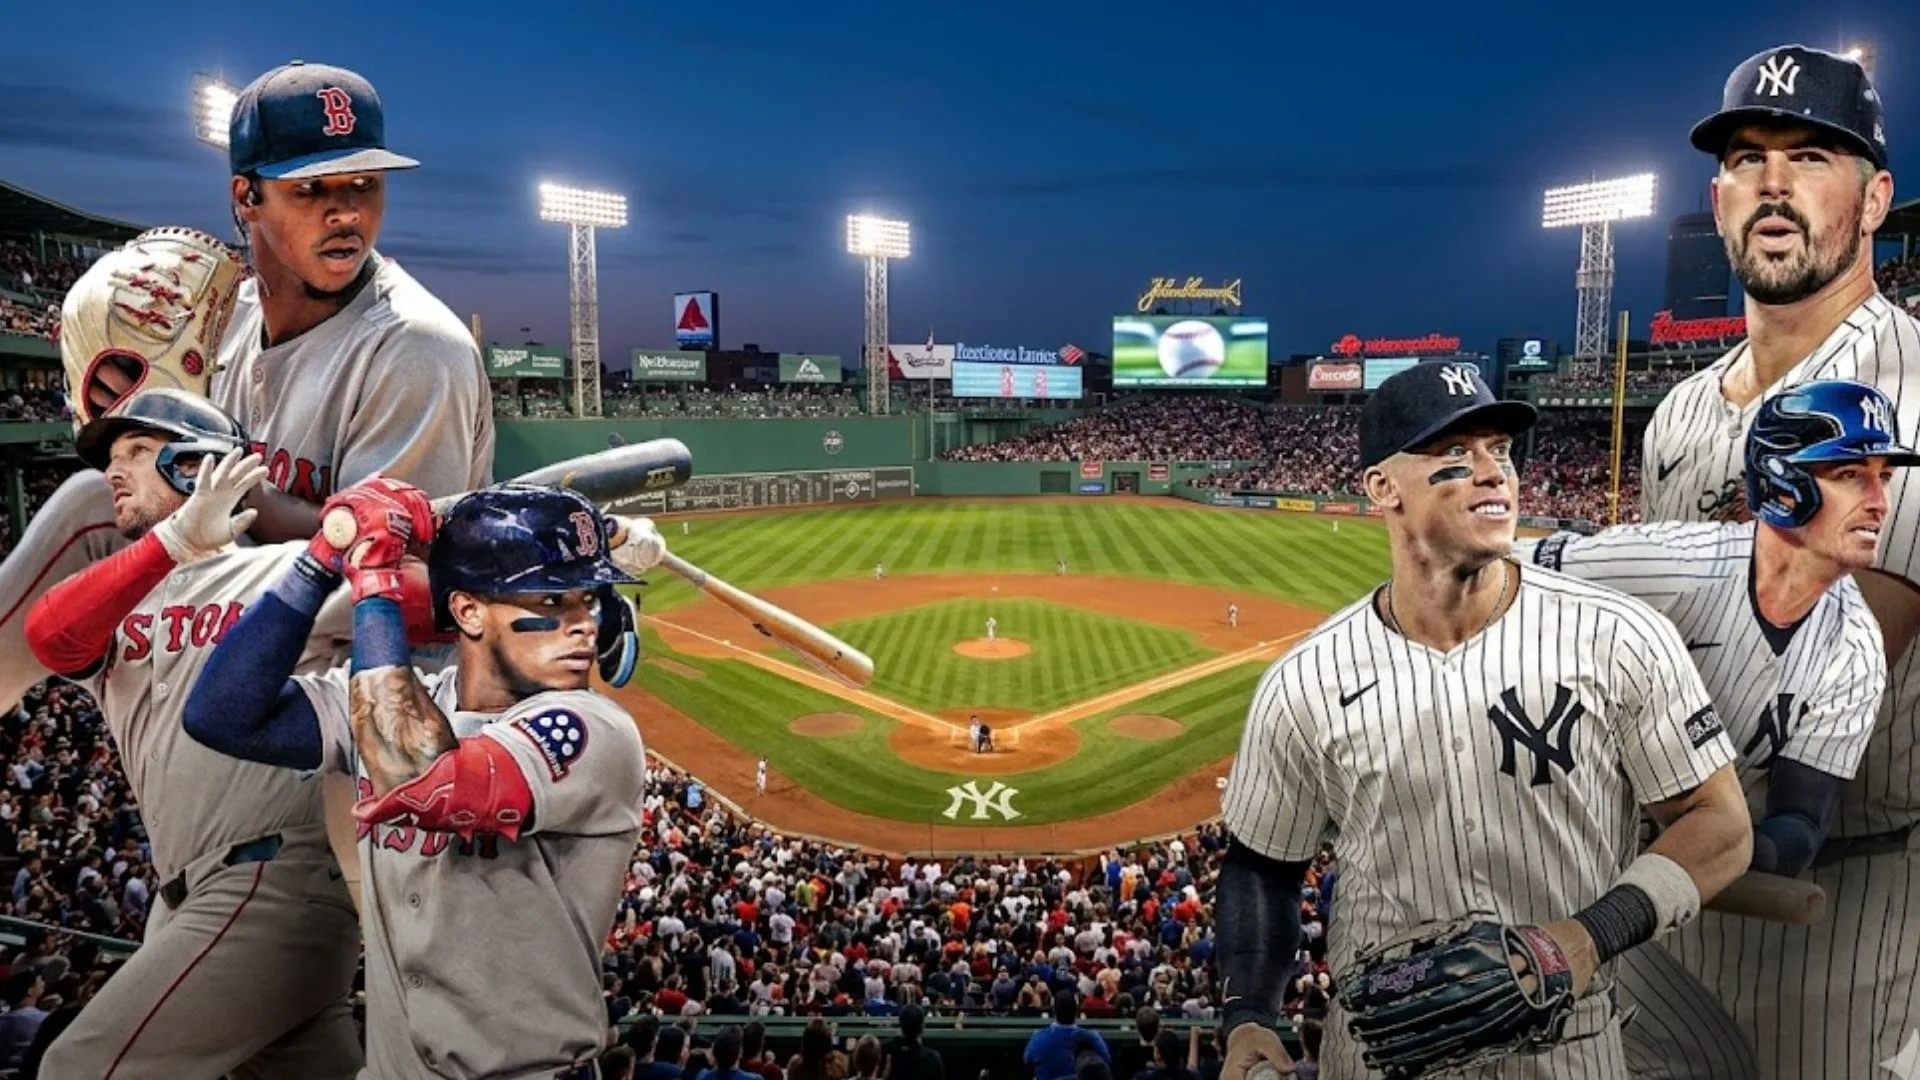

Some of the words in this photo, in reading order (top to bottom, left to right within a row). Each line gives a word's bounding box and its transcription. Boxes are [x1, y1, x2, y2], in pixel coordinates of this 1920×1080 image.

[1755, 55, 1800, 96] NY
[316, 87, 357, 136] B
[1440, 365, 1478, 396] NY
[1859, 396, 1893, 437] NY
[568, 511, 599, 558] B
[1487, 682, 1586, 787] NY
[941, 780, 1022, 821] NY
